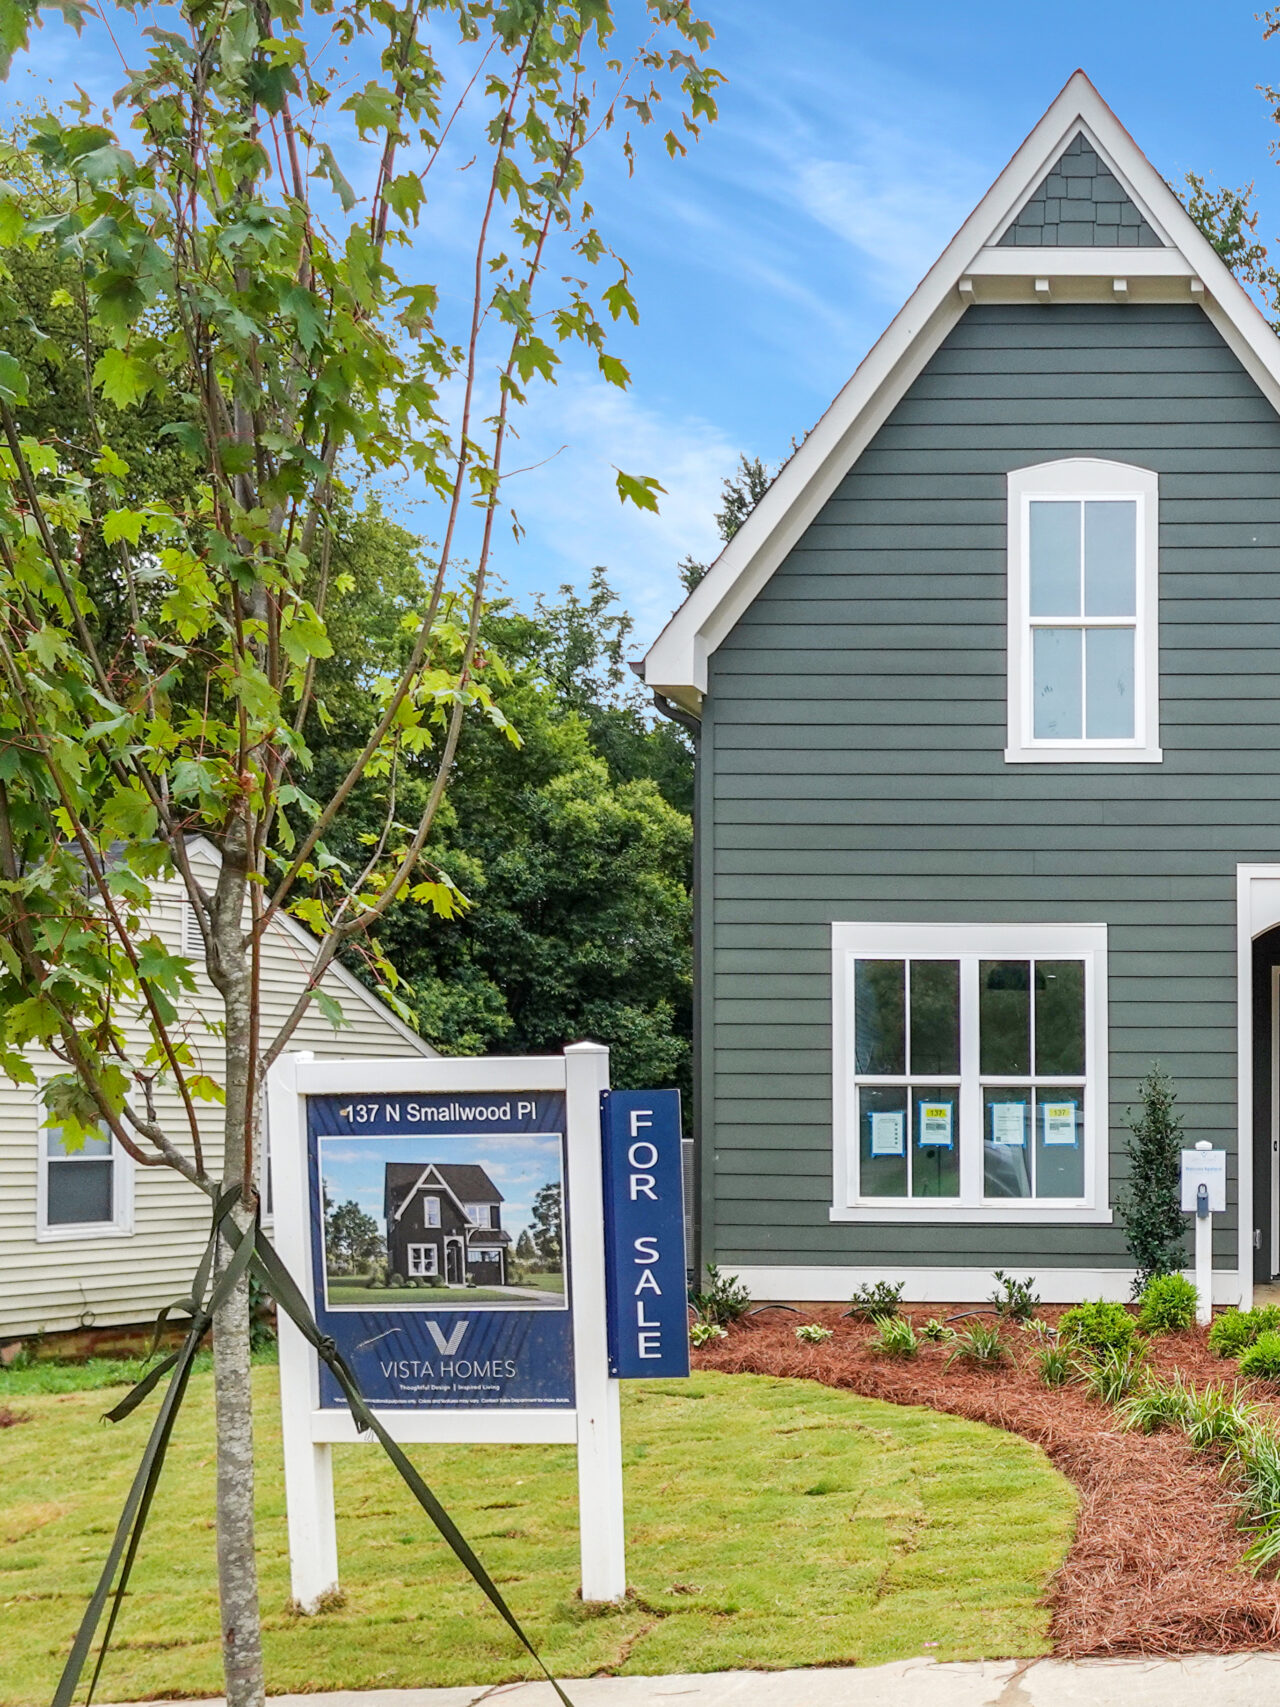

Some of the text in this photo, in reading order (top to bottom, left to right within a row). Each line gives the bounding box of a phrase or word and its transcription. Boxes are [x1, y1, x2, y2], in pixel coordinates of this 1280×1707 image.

[346, 1101, 537, 1123] 137 N Smallwood Pl
[930, 1109, 943, 1117] 137
[1053, 1108, 1066, 1117] 137
[628, 1110, 659, 1201] FOR
[633, 1236, 662, 1359] SALE
[380, 1359, 516, 1379] VISTA HOMES
[431, 1384, 451, 1392] Design
[458, 1384, 482, 1392] Inspired
